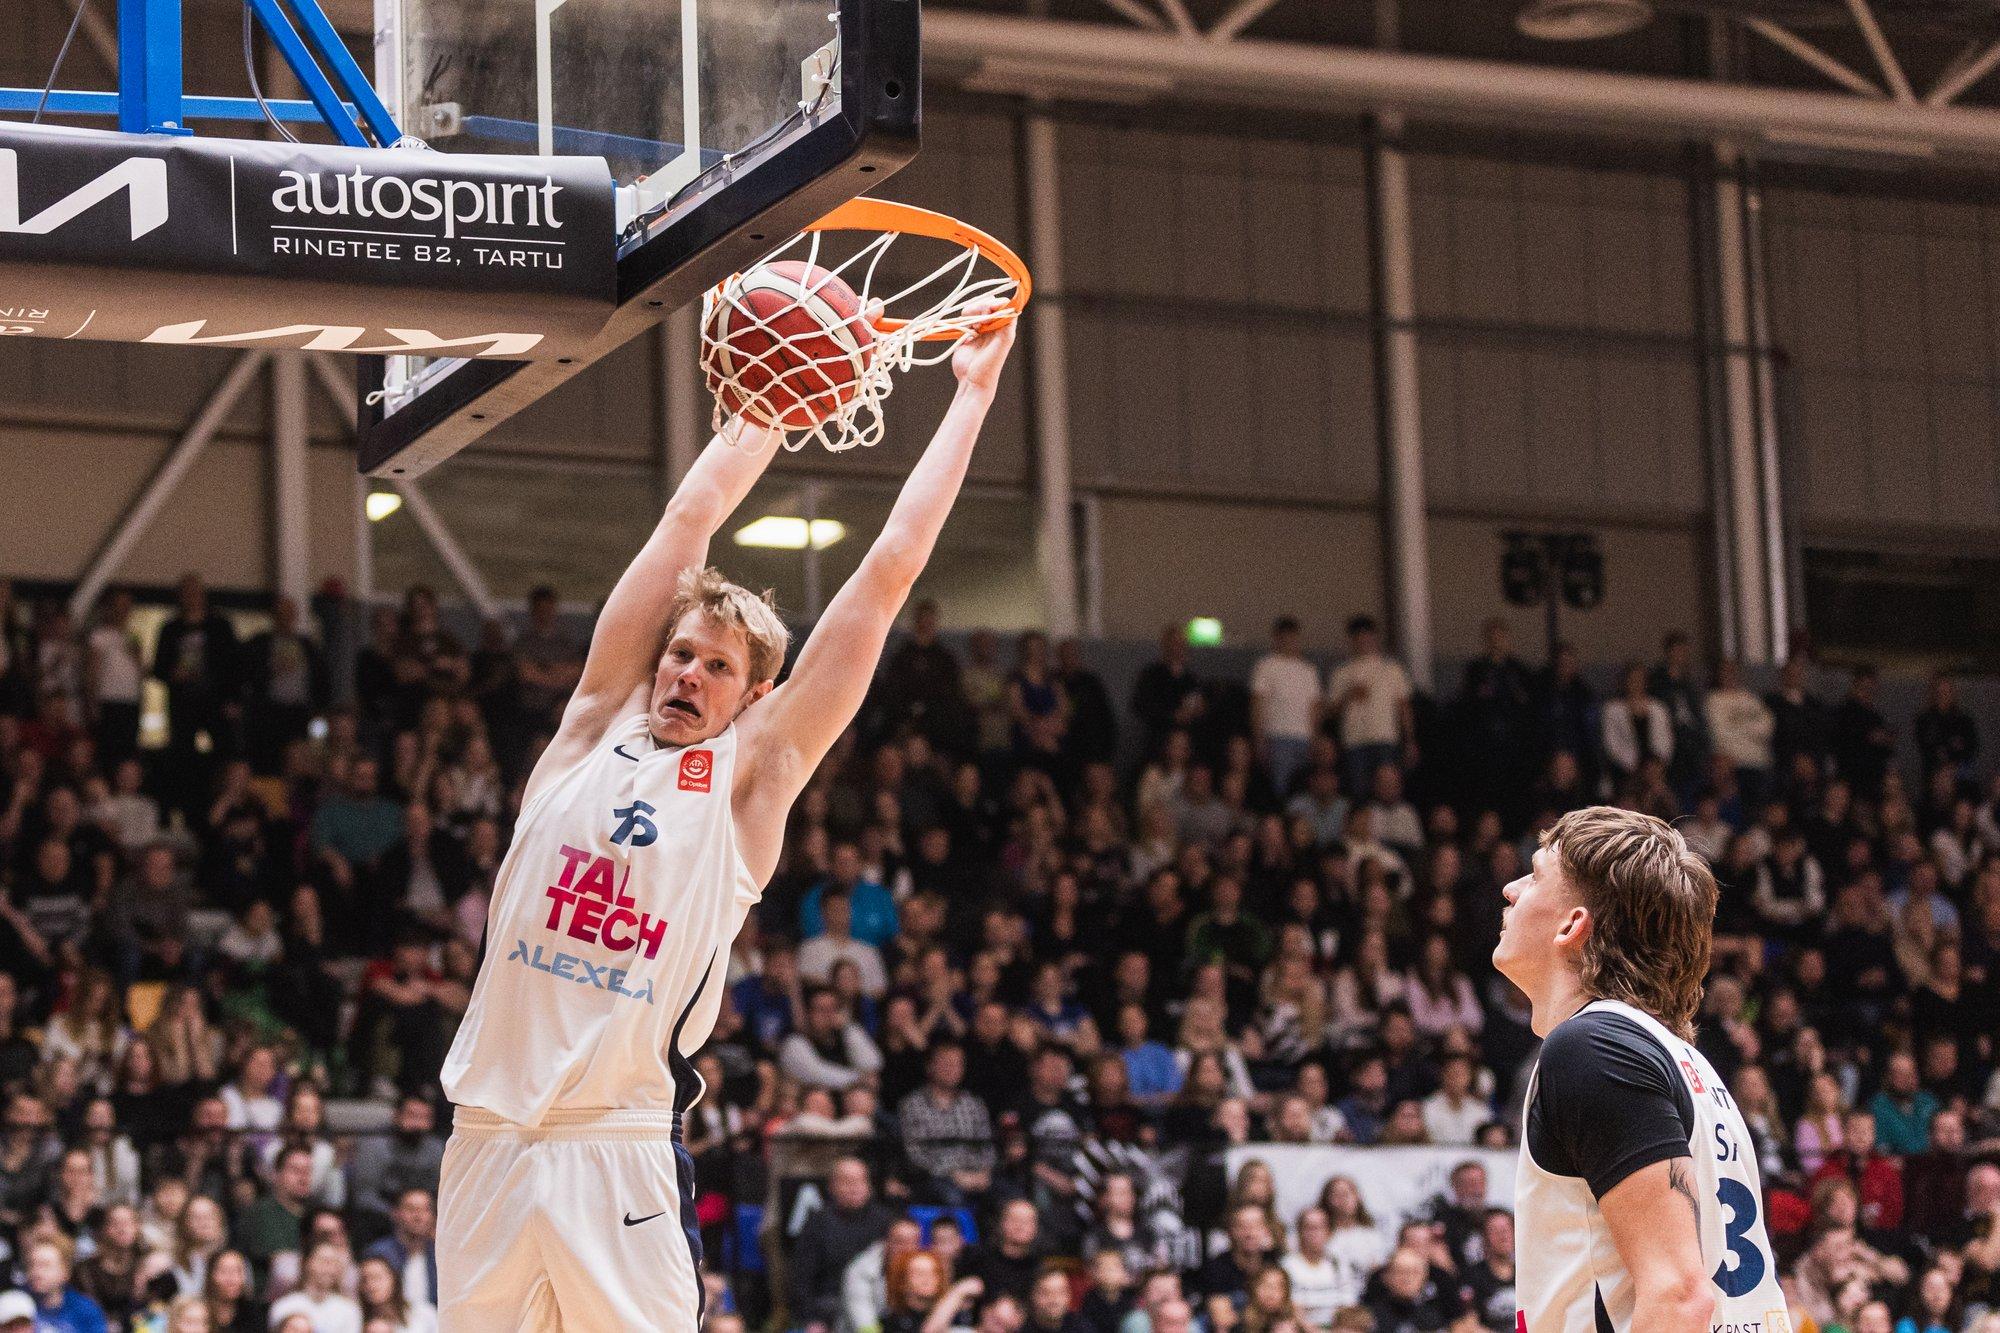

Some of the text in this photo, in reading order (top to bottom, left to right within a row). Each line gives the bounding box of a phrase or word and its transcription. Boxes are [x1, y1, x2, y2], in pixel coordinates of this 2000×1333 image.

[271, 164, 564, 239] autospirit
[273, 237, 562, 269] RINGTEE 82, TARTU
[557, 844, 636, 909] TAL
[545, 886, 668, 961] TECH
[1711, 1177, 1765, 1297] 3
